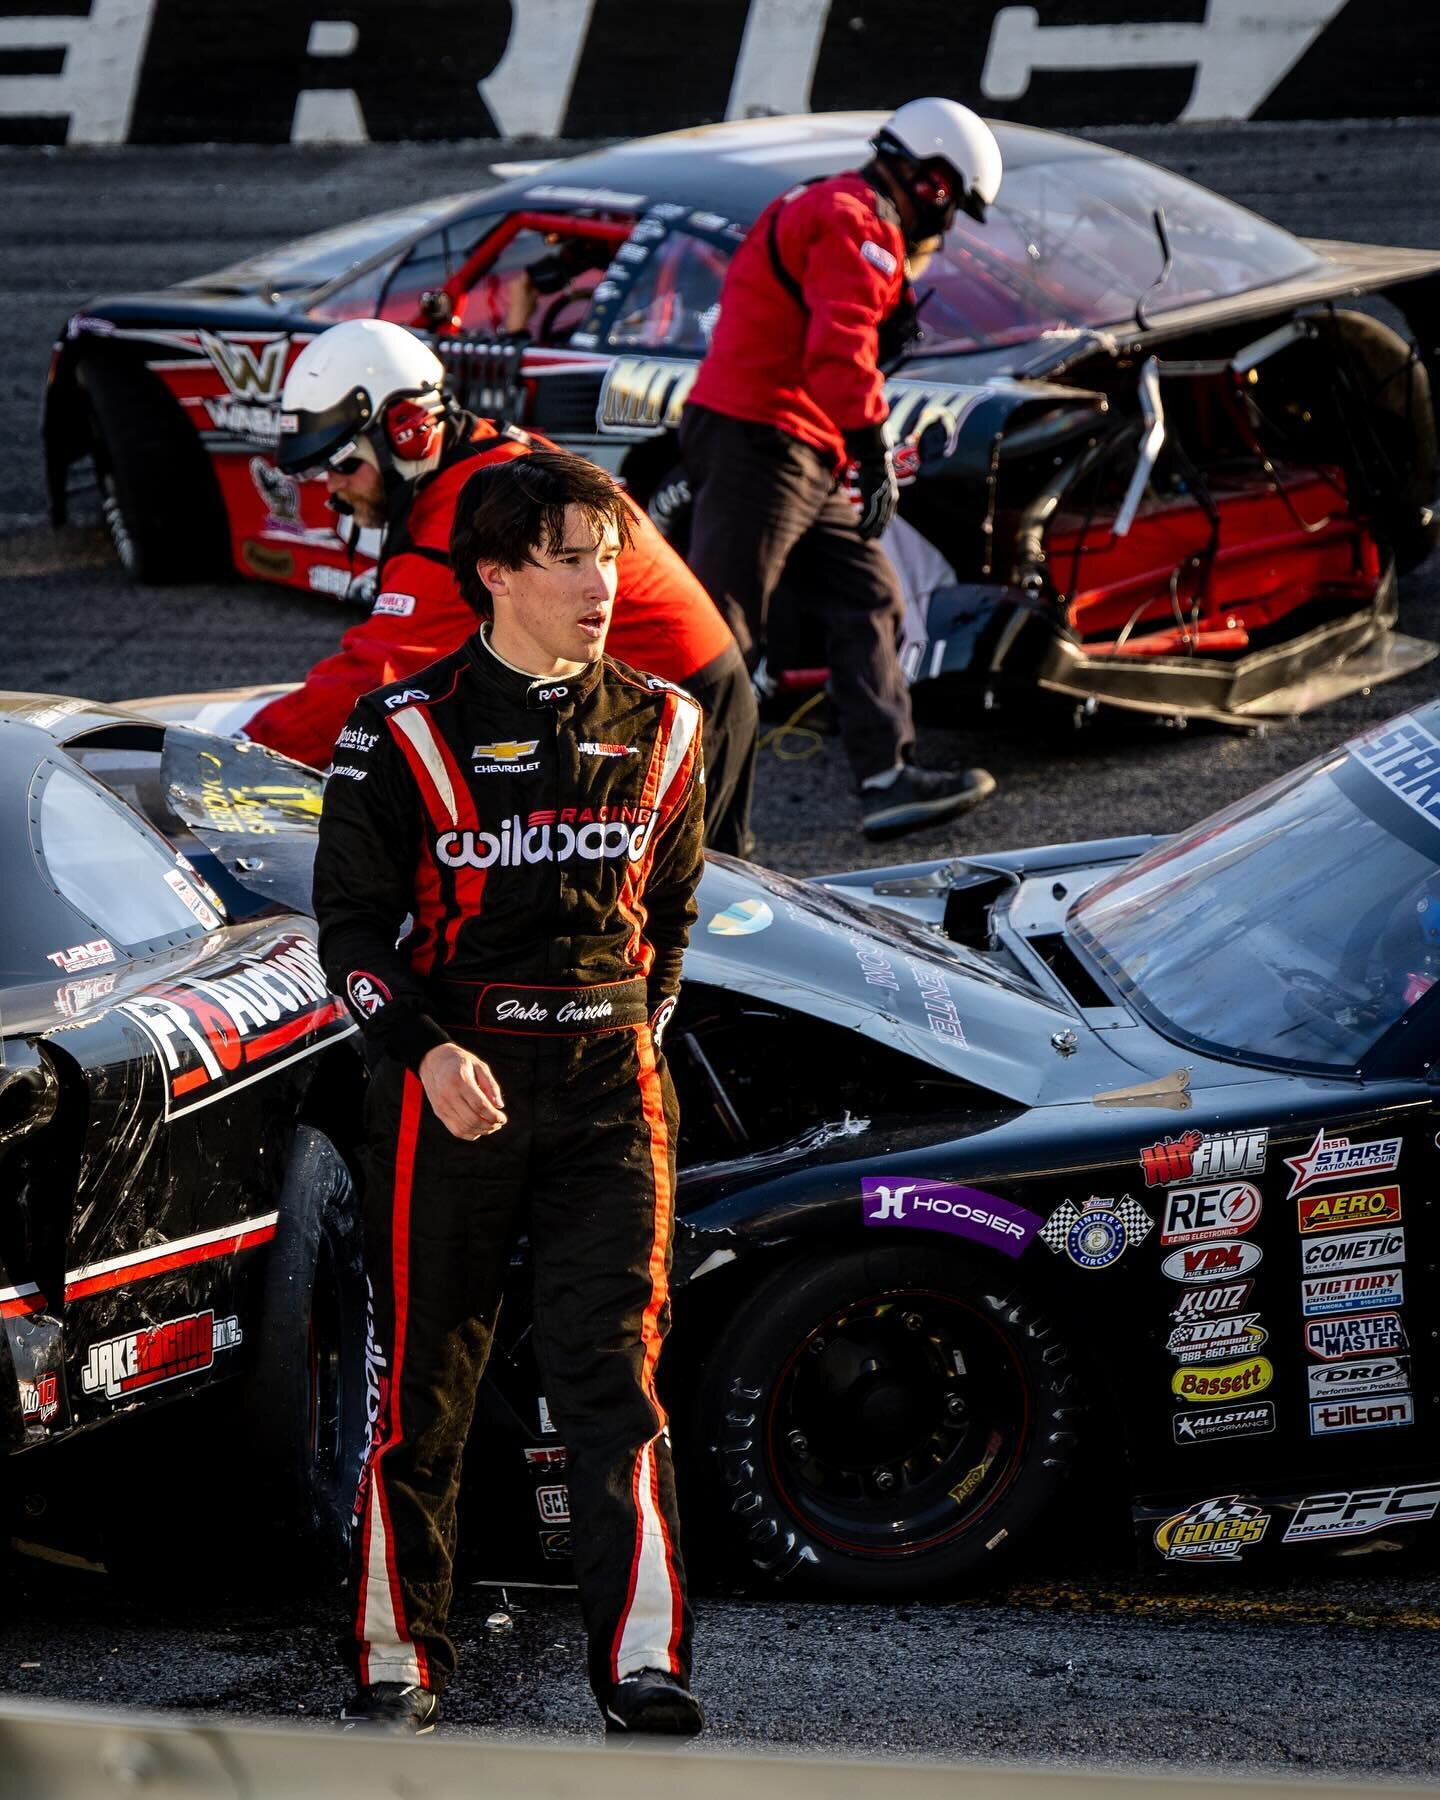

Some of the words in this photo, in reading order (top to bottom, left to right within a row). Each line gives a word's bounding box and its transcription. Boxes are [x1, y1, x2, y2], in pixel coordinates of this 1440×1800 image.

[538, 686, 569, 701] RAD
[474, 761, 541, 774] CHEVROLET
[560, 806, 652, 824] RACING
[436, 809, 660, 869] wilwood
[495, 999, 549, 1022] Jake
[556, 998, 613, 1023] Garcia
[1316, 1141, 1399, 1166] STARS
[1322, 1138, 1348, 1150] ASA
[1192, 1134, 1267, 1175] FIVE
[1313, 1159, 1366, 1173] NATIONAL
[1368, 1154, 1396, 1165] TOUR
[1309, 1192, 1386, 1218] AERO
[913, 1196, 1026, 1240] HOOSIER
[1071, 1213, 1123, 1235] WINNER'S
[1191, 1227, 1239, 1241] ELECTRONICS
[1080, 1252, 1115, 1266] CIRCLE
[1184, 1270, 1203, 1278] FUEL
[1203, 1265, 1239, 1275] SYSTEMS
[1304, 1273, 1400, 1297] VICTORY
[1348, 1287, 1393, 1299] TRAILERS
[1179, 1284, 1248, 1313] KLOTZ
[1190, 1317, 1254, 1341] DAY
[1308, 1316, 1398, 1348] QUARTER
[1210, 1334, 1262, 1348] PRODUCTS
[1324, 1331, 1404, 1357] MASTER
[1181, 1364, 1262, 1395] Bassett
[1324, 1364, 1396, 1383] DRP
[1315, 1385, 1369, 1396] Performance
[1369, 1380, 1406, 1391] Products
[1193, 1409, 1269, 1427] ALLSTAR
[1318, 1404, 1407, 1428] tilton
[1194, 1419, 1270, 1435] PERFORMANCE
[959, 1471, 982, 1500] AERO
[1293, 1484, 1440, 1526] PFC
[1288, 1519, 1368, 1534] BRAKES
[1169, 1539, 1240, 1557] Racing
